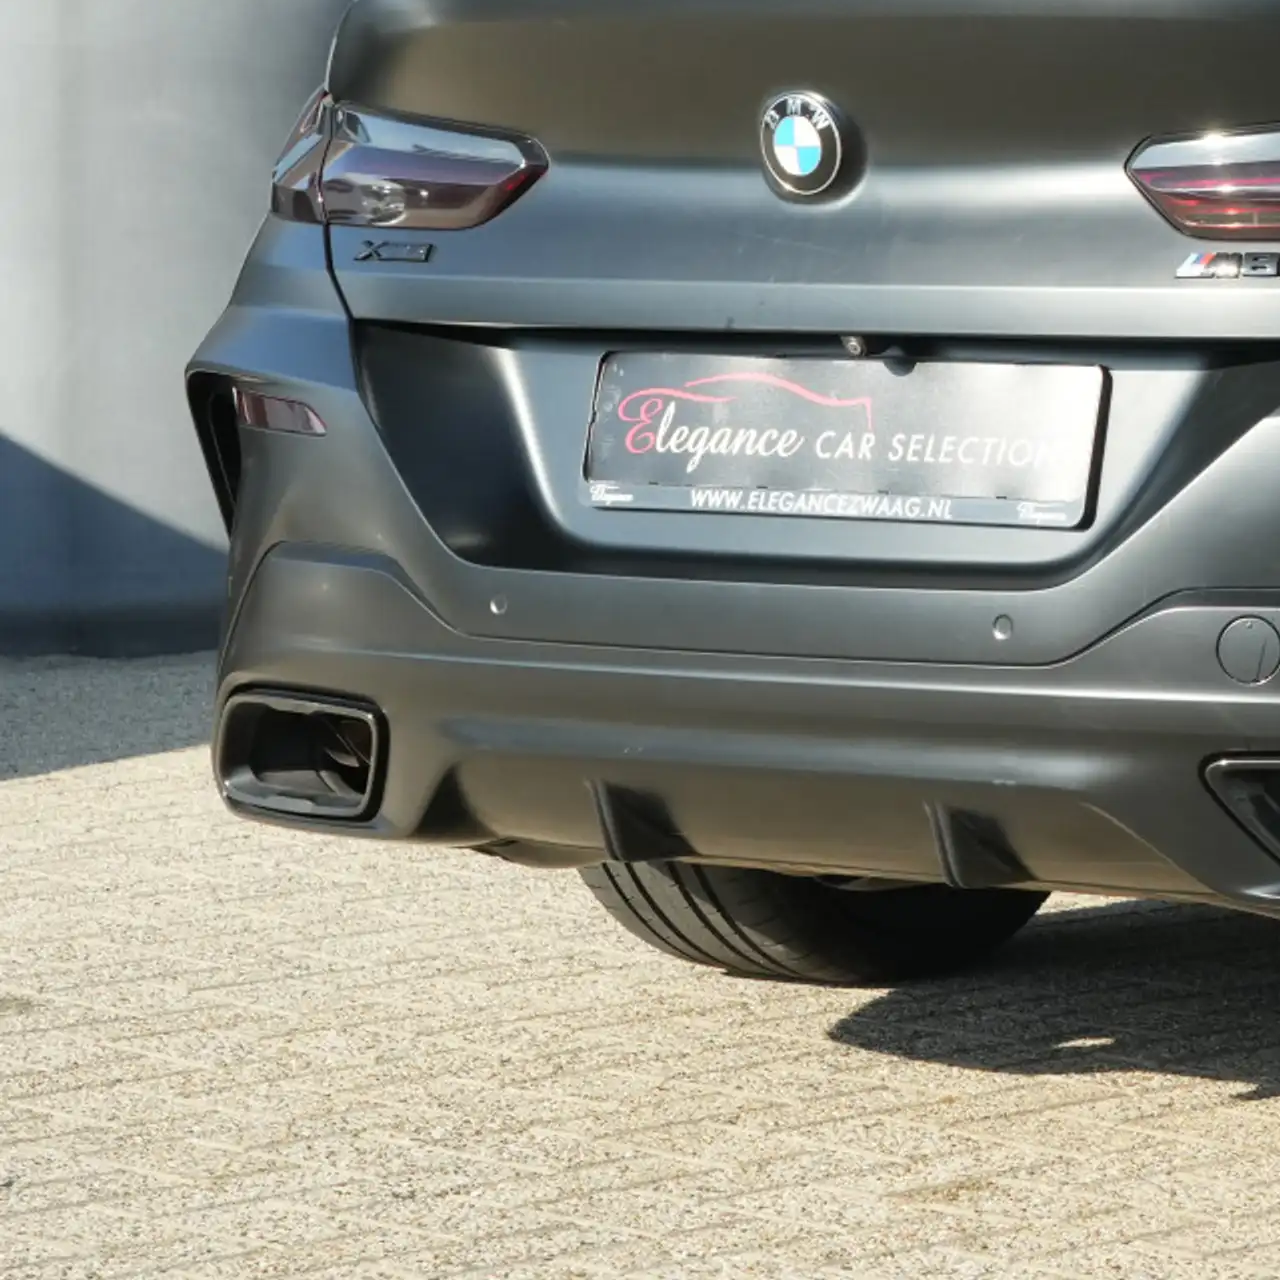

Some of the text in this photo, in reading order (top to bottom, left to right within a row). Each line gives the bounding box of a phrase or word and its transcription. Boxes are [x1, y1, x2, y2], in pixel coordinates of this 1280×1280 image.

[618, 389, 805, 474] Elegance
[815, 430, 876, 462] CAR
[689, 487, 954, 520] WWW.ELEGANCEZWAAG.NL
